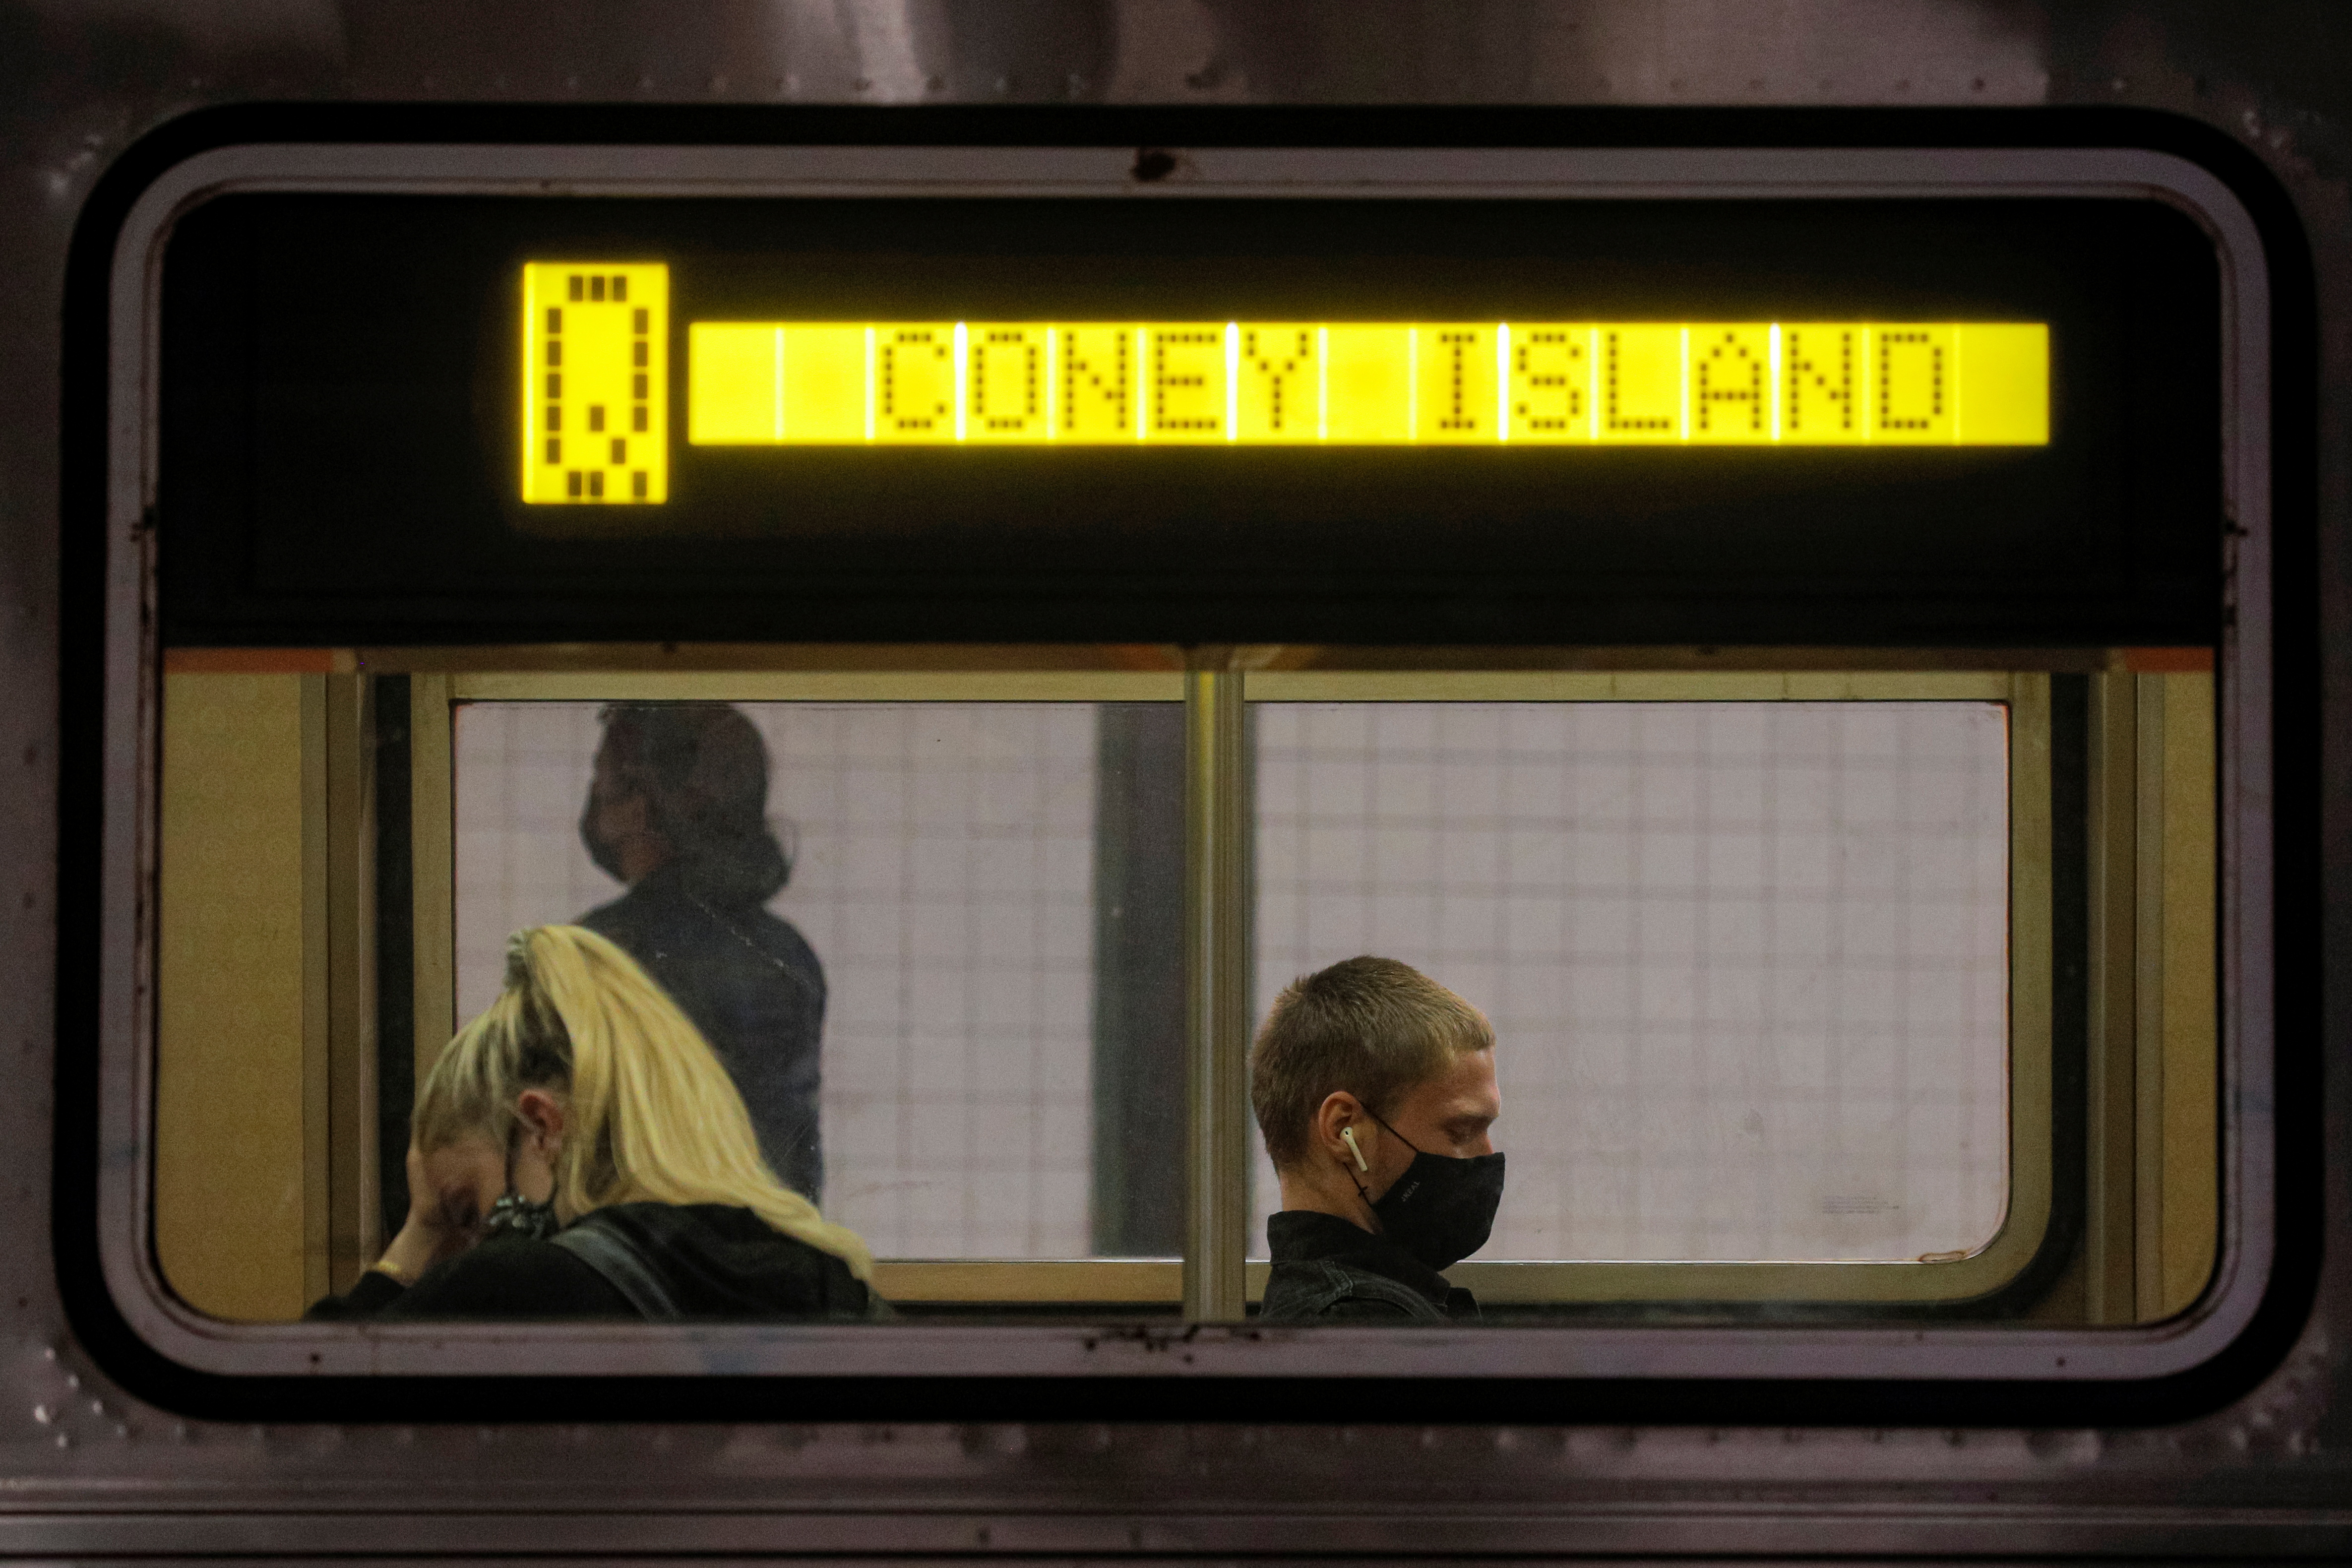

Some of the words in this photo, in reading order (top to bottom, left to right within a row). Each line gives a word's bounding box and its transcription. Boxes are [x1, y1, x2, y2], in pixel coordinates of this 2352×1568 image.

[547, 276, 649, 497] Q
[884, 332, 1308, 429] CONEY
[1439, 333, 1942, 430] ISLAND
